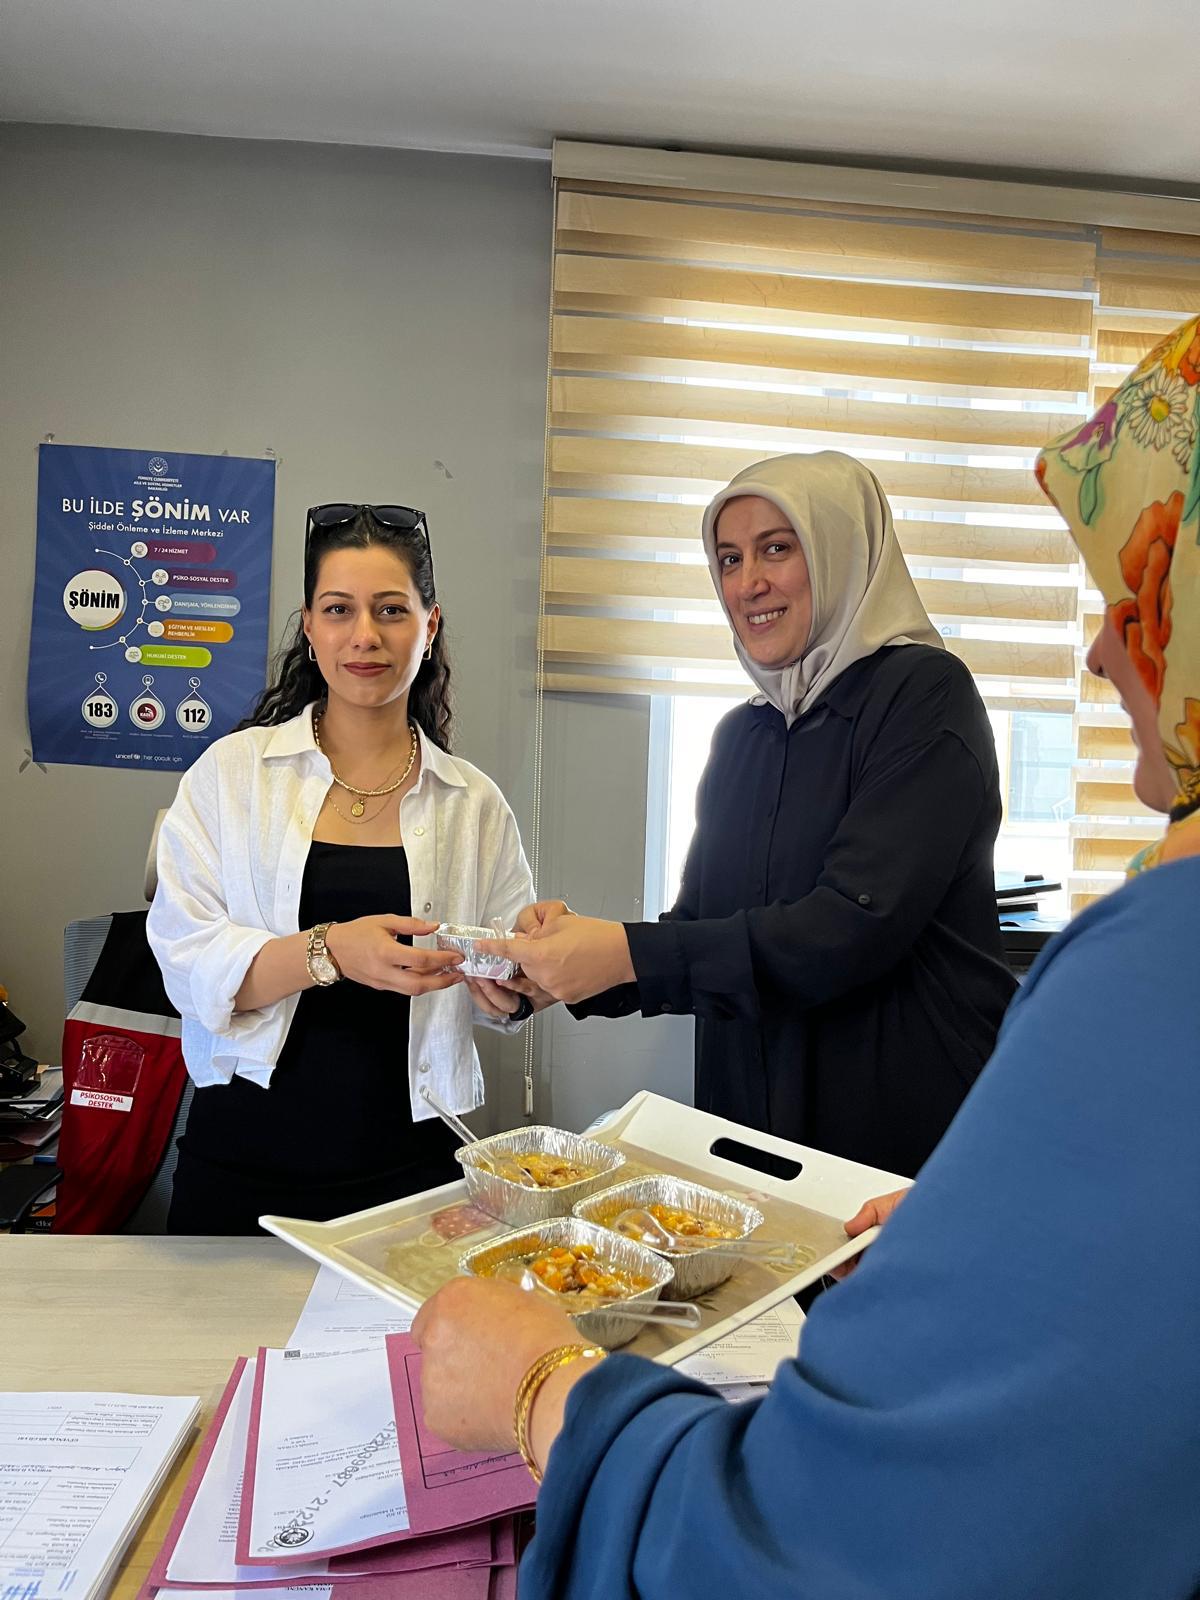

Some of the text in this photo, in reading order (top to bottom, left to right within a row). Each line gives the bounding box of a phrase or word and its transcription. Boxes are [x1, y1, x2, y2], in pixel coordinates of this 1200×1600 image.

[62, 496, 250, 524] BU İLDE ŞÖNİM VAR
[89, 522, 114, 533] Şiddet
[117, 522, 148, 533] Önleme
[163, 525, 188, 536] İzleme
[191, 528, 223, 538] Merkezi
[69, 589, 120, 611] ŞÖNİM
[87, 702, 113, 718] 183
[183, 708, 206, 723] 112
[80, 1091, 124, 1103] PSİKOSOSYAL
[88, 1100, 113, 1108] DESTEK
